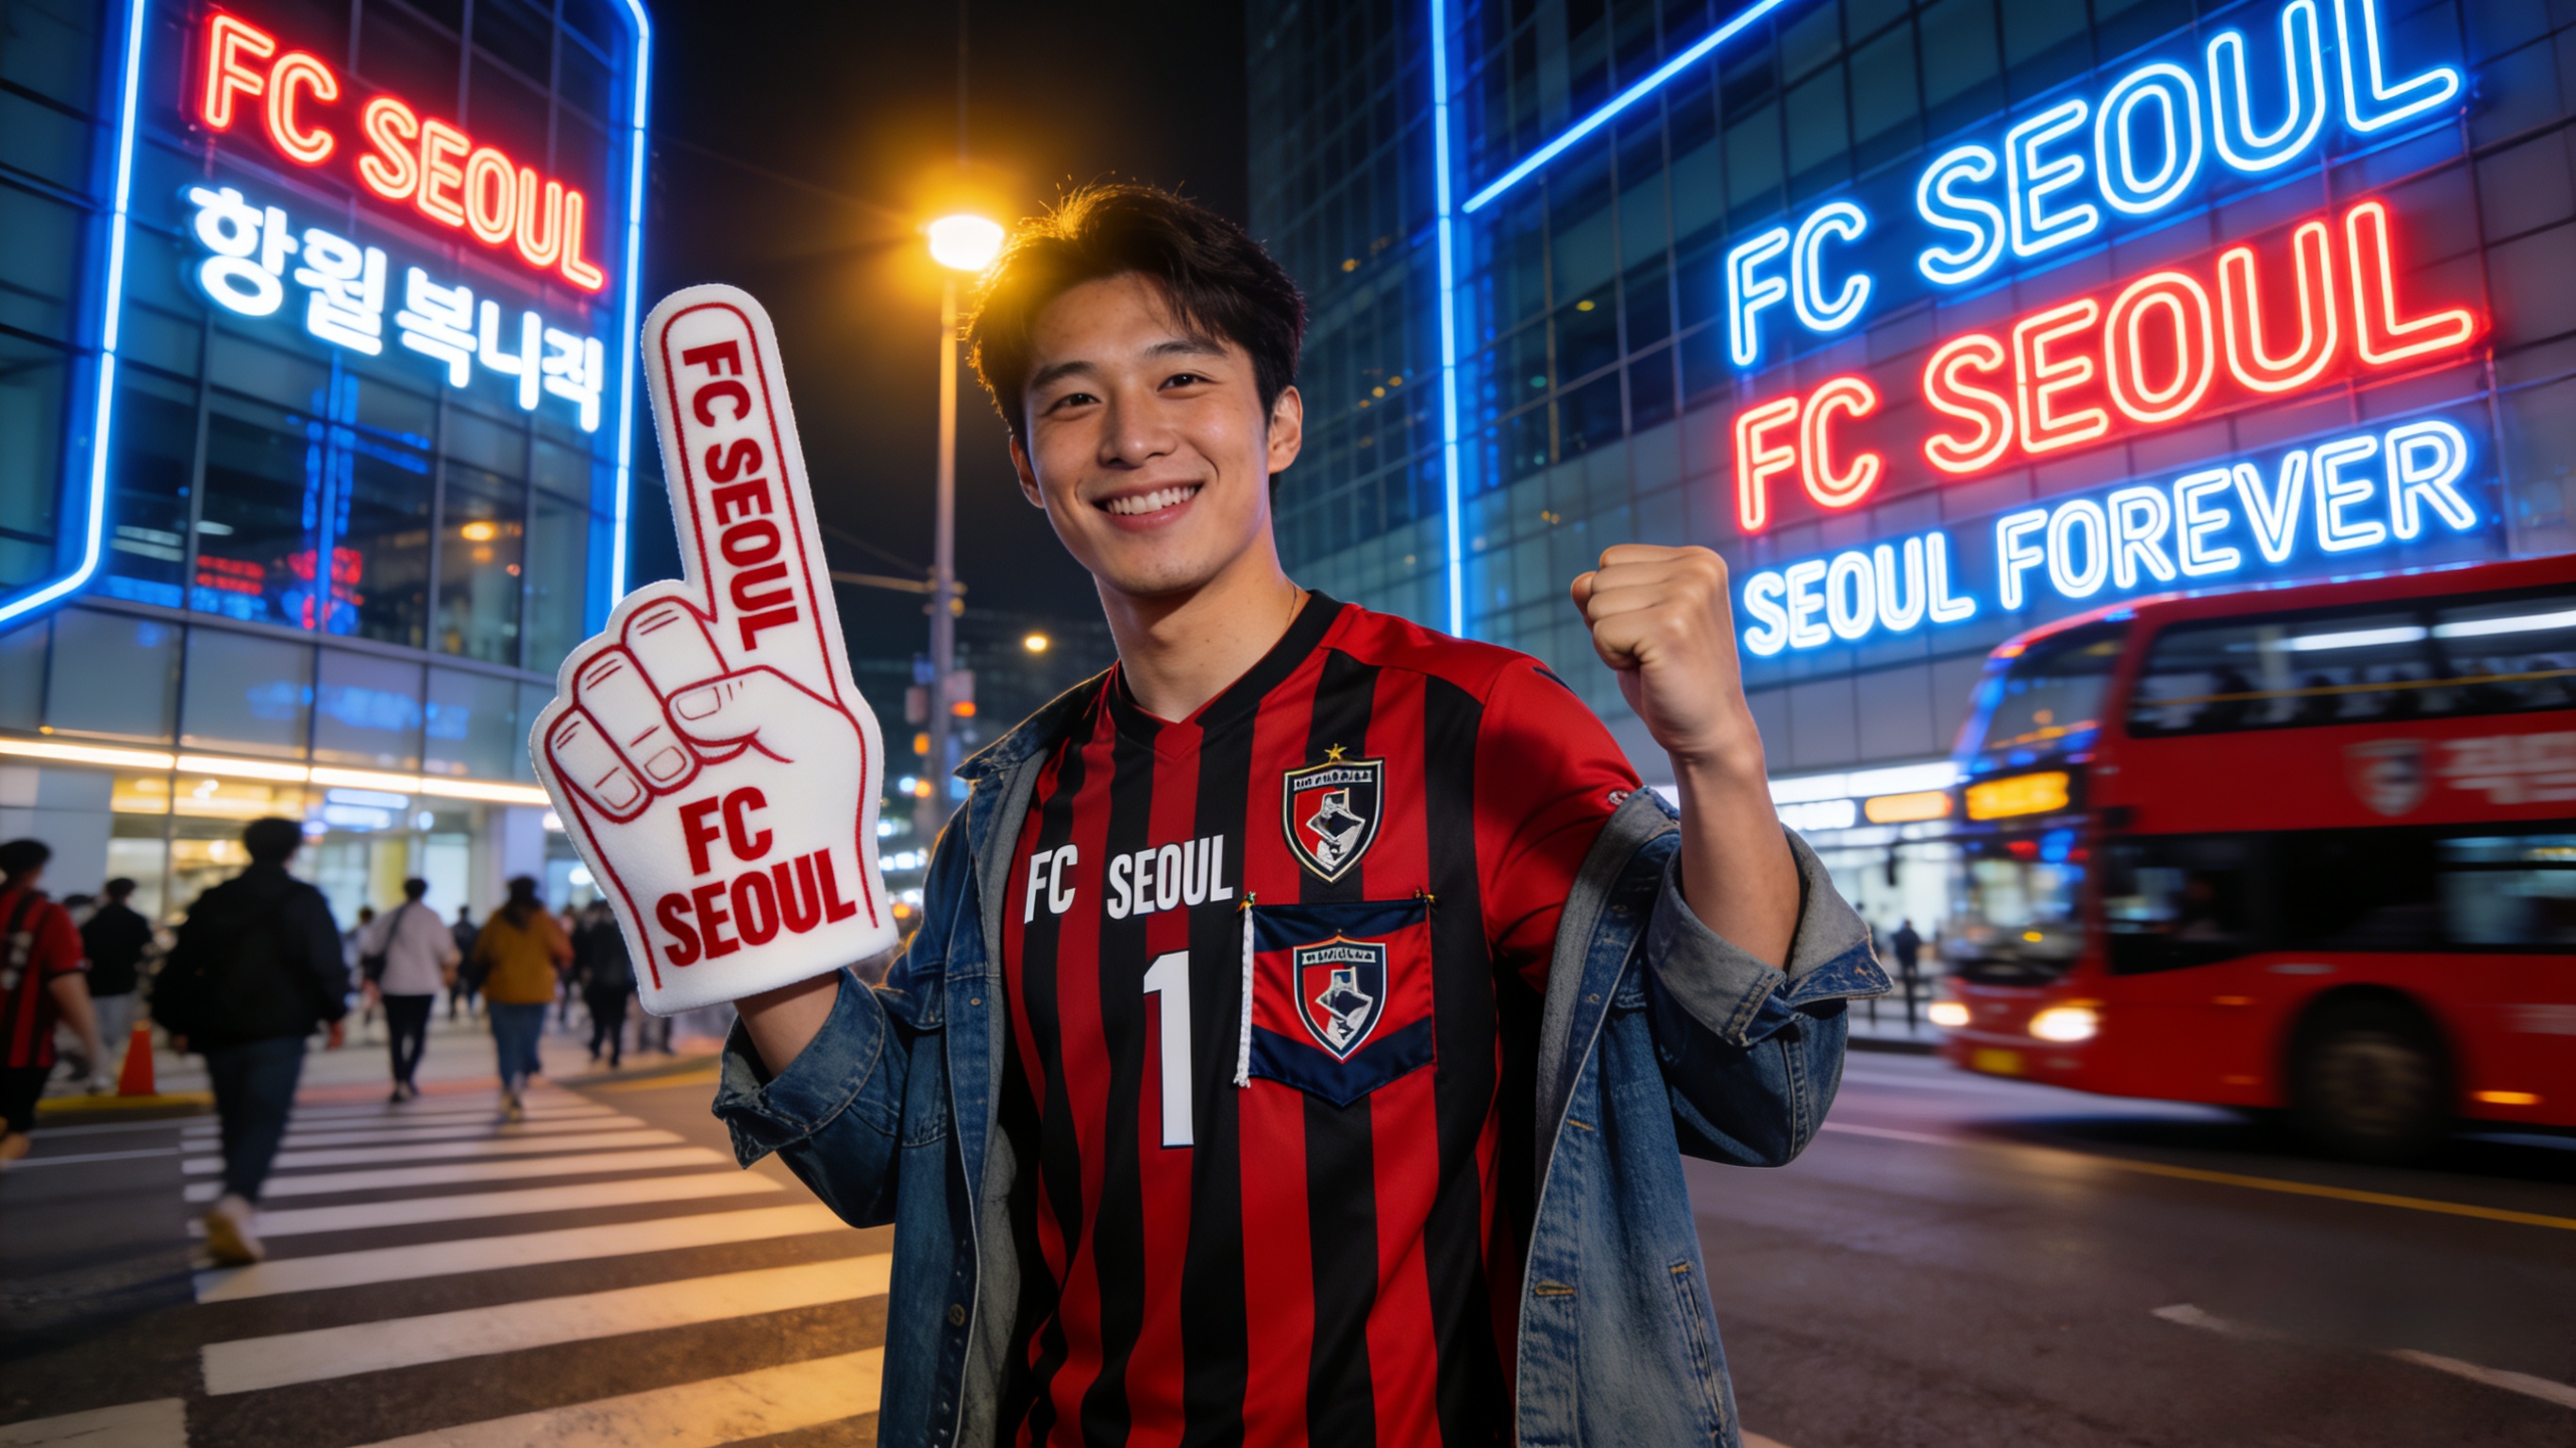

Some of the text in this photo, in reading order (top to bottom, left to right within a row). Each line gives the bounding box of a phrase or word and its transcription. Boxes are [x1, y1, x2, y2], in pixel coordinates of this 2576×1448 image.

[205, 14, 604, 291] FC SEOUL
[1728, 0, 2459, 366] FC SEOUL
[1735, 201, 2474, 531] FC SEOUL
[682, 340, 799, 653] FC SEOUL
[1743, 420, 2477, 657] SEOUL FOREVER
[656, 848, 857, 968] SEOUL
[678, 786, 773, 876] FC
[1024, 834, 1233, 924] FC SEOUL
[1143, 950, 1195, 1147] 1
